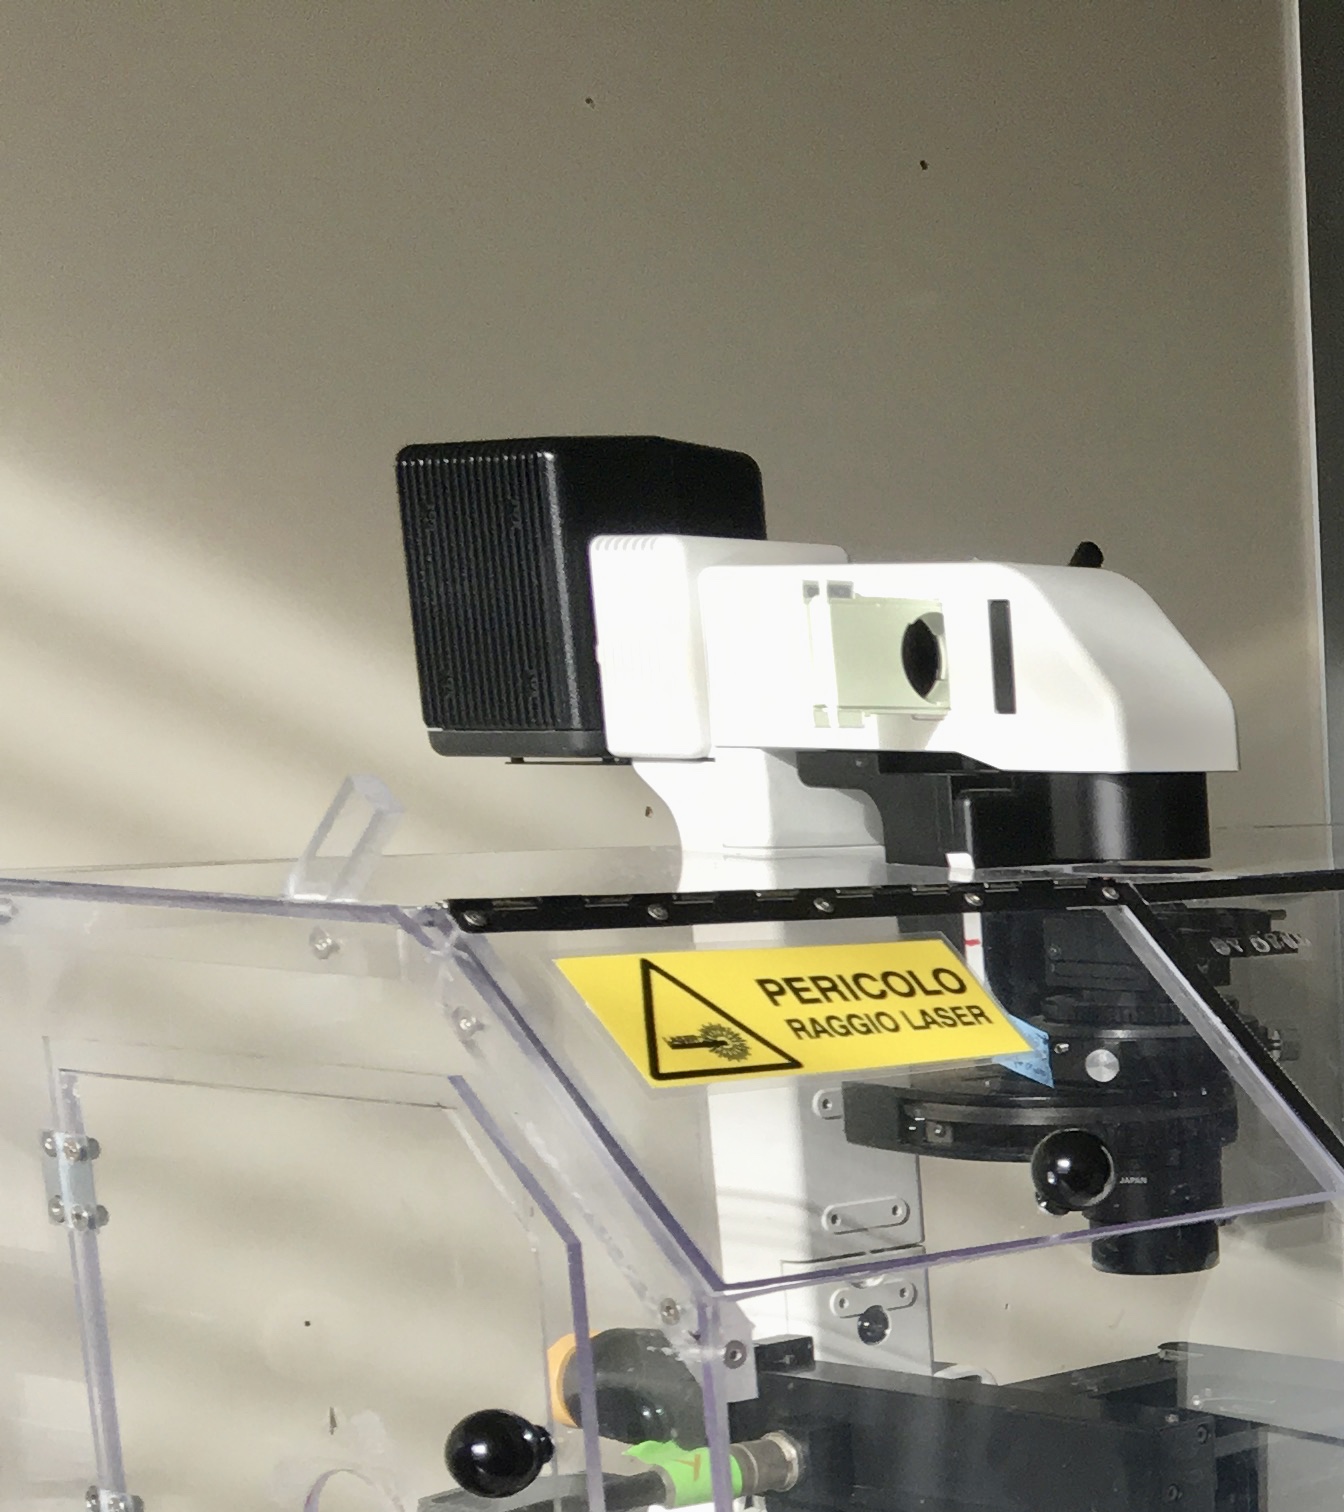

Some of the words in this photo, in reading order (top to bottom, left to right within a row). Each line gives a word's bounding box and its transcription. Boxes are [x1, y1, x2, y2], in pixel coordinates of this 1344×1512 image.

[755, 967, 968, 1007] PERICOLO
[785, 1011, 901, 1040] RAGGIO
[900, 1004, 994, 1031] LASER
